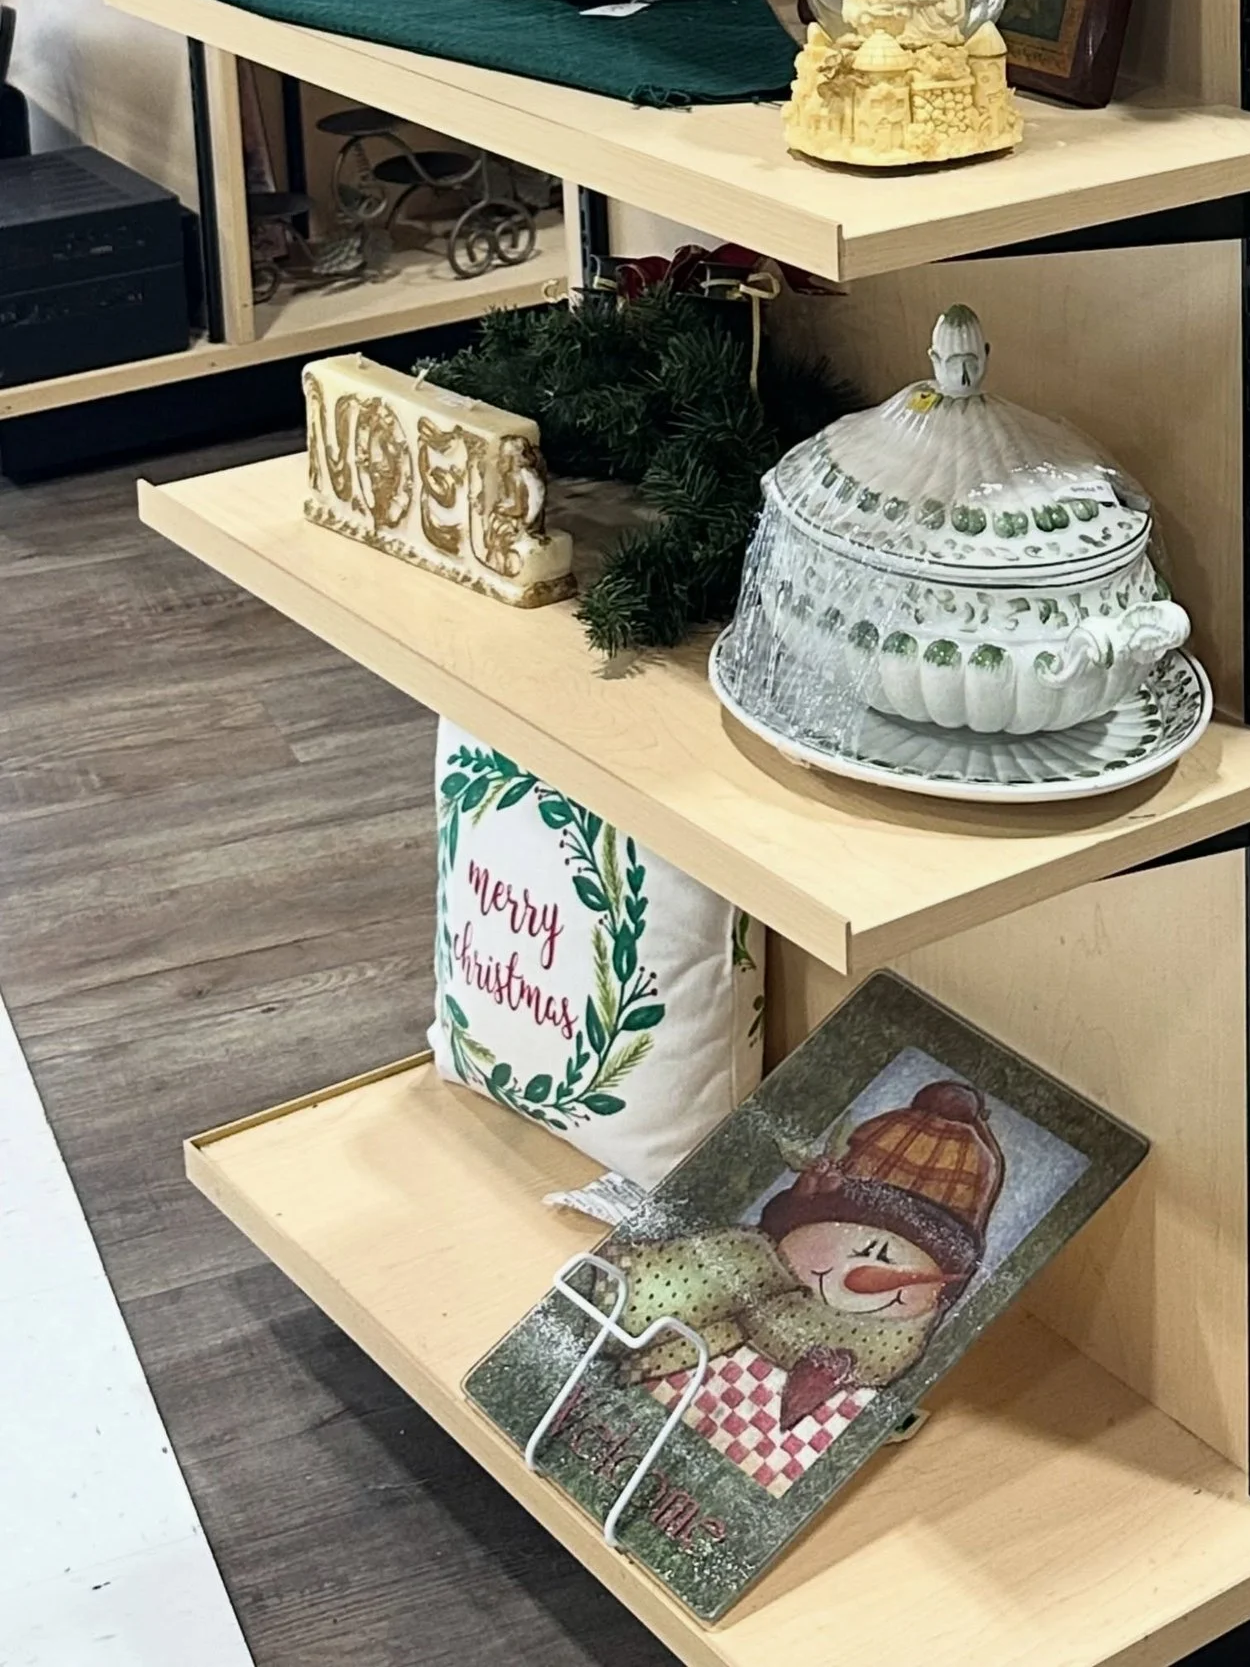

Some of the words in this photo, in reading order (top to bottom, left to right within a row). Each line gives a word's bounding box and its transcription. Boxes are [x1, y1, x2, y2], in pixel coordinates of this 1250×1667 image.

[304, 372, 523, 578] NOEL
[468, 859, 564, 970] merry
[453, 920, 578, 1040] christmas
